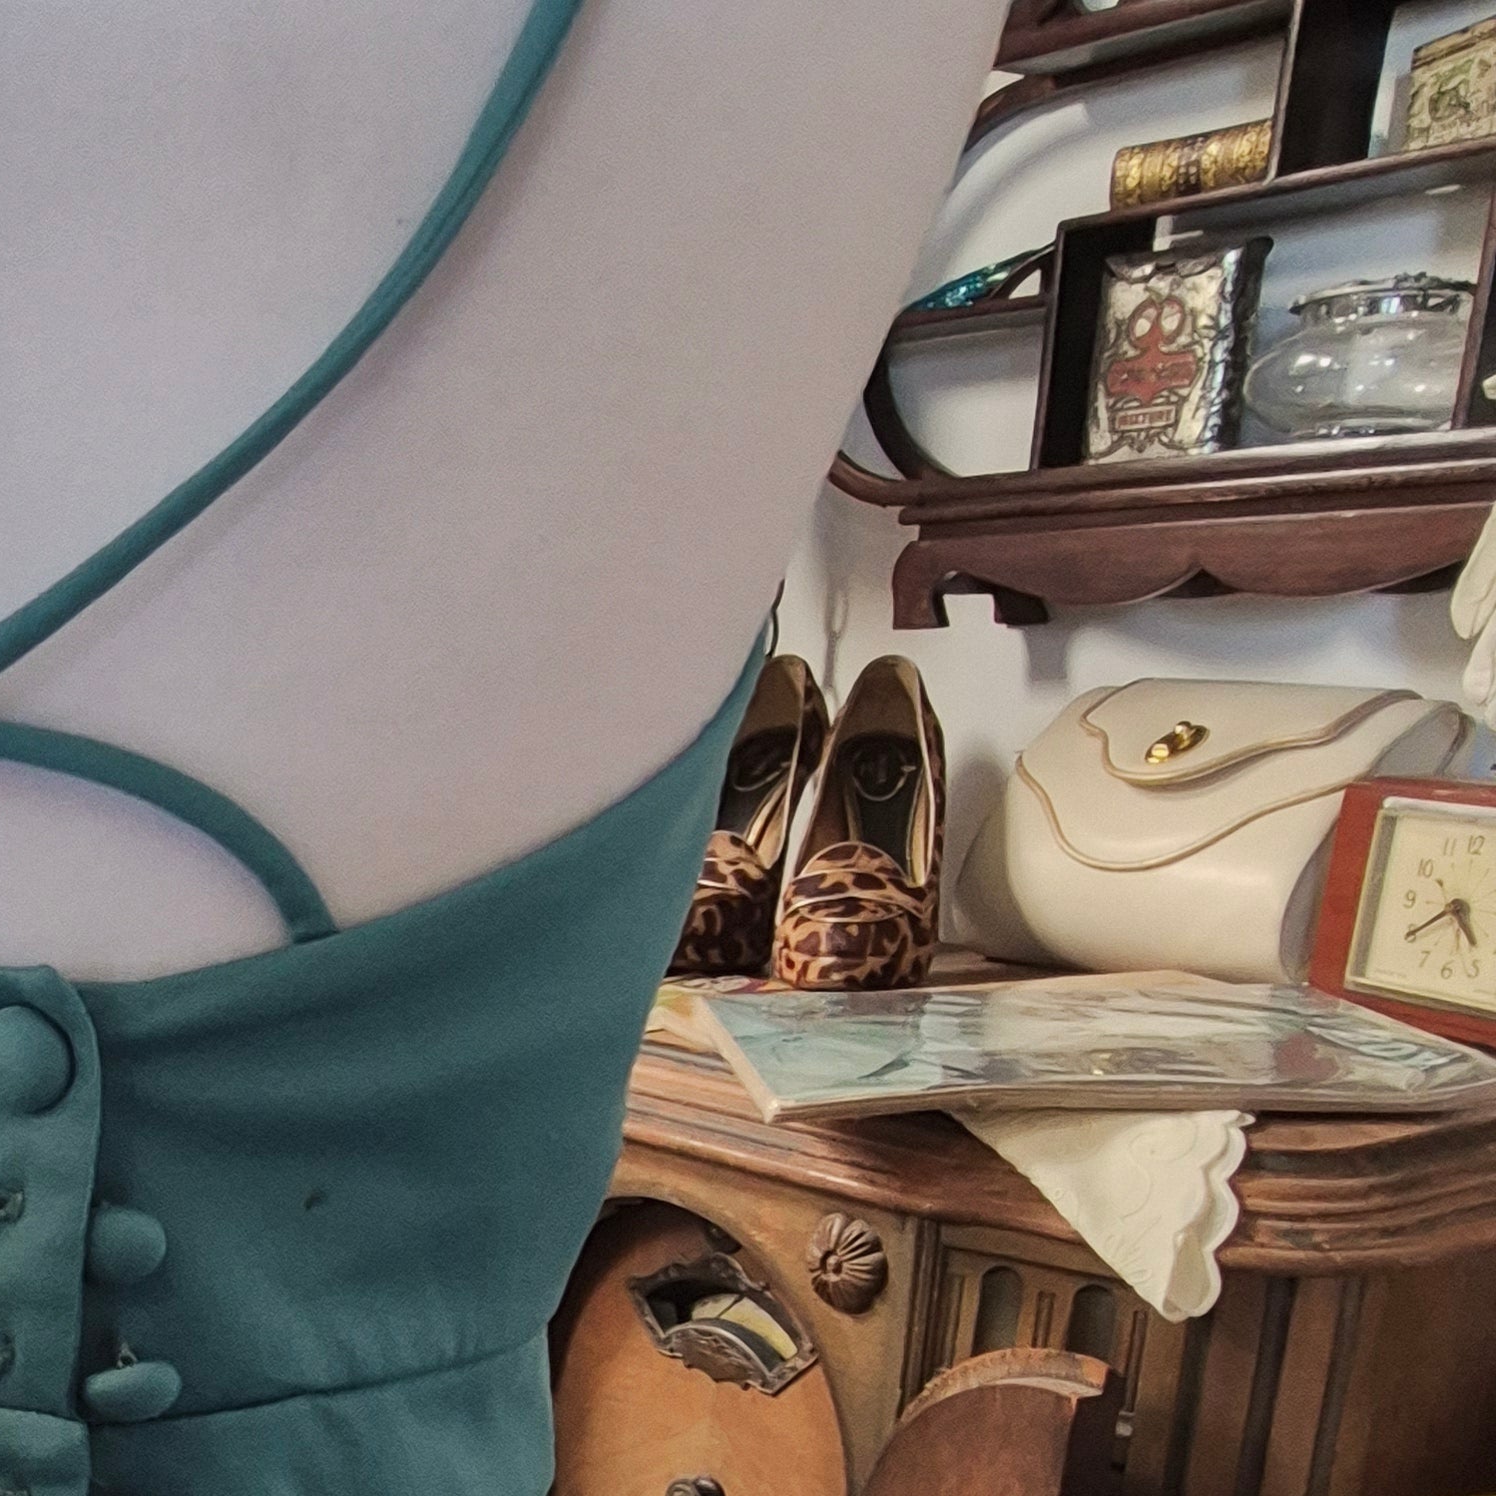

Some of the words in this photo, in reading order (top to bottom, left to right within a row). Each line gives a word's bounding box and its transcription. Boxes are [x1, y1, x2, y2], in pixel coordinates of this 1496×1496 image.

[1467, 835, 1486, 856] 12
[1417, 858, 1434, 878] 10
[1403, 889, 1417, 909] 9
[1418, 949, 1431, 968] 7
[1440, 960, 1455, 980] 6
